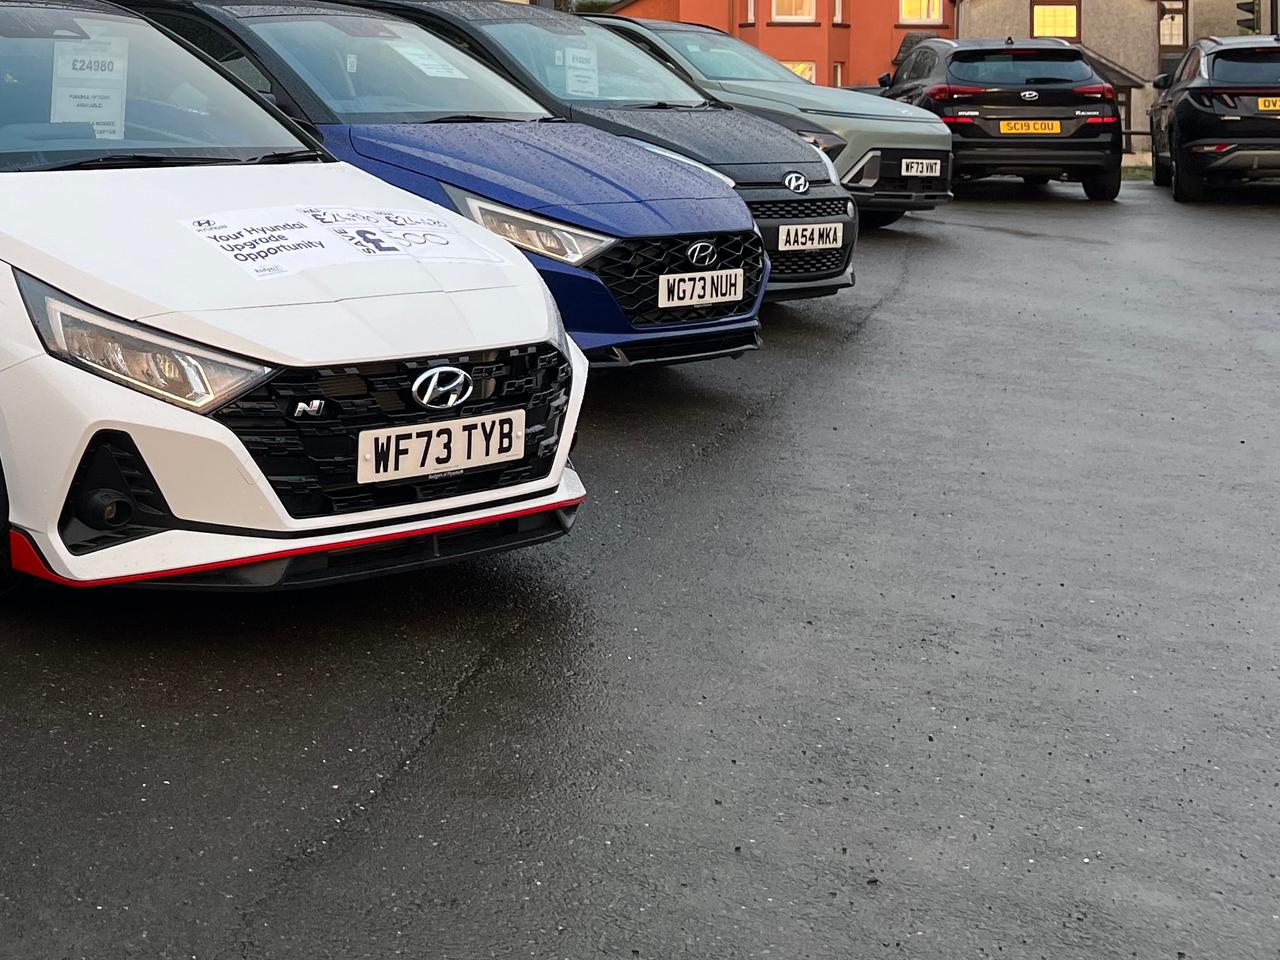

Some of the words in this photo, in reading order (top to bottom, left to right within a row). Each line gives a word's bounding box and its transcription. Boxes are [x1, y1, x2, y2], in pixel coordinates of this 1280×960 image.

[71, 59, 114, 72] £24980
[1006, 122, 1030, 132] SC19
[1033, 122, 1054, 131] COU
[905, 161, 924, 174] WF73
[207, 230, 244, 244] Your
[243, 221, 308, 235] Hyundai
[220, 233, 289, 252] Upgrade
[334, 227, 376, 254] SAVE
[784, 227, 815, 247] AA54
[817, 226, 838, 245] MKA
[234, 240, 325, 262] Opportunity
[666, 276, 707, 302] WG73
[710, 273, 738, 298] NUH
[373, 427, 453, 475] WF73
[461, 417, 514, 460] TYB
